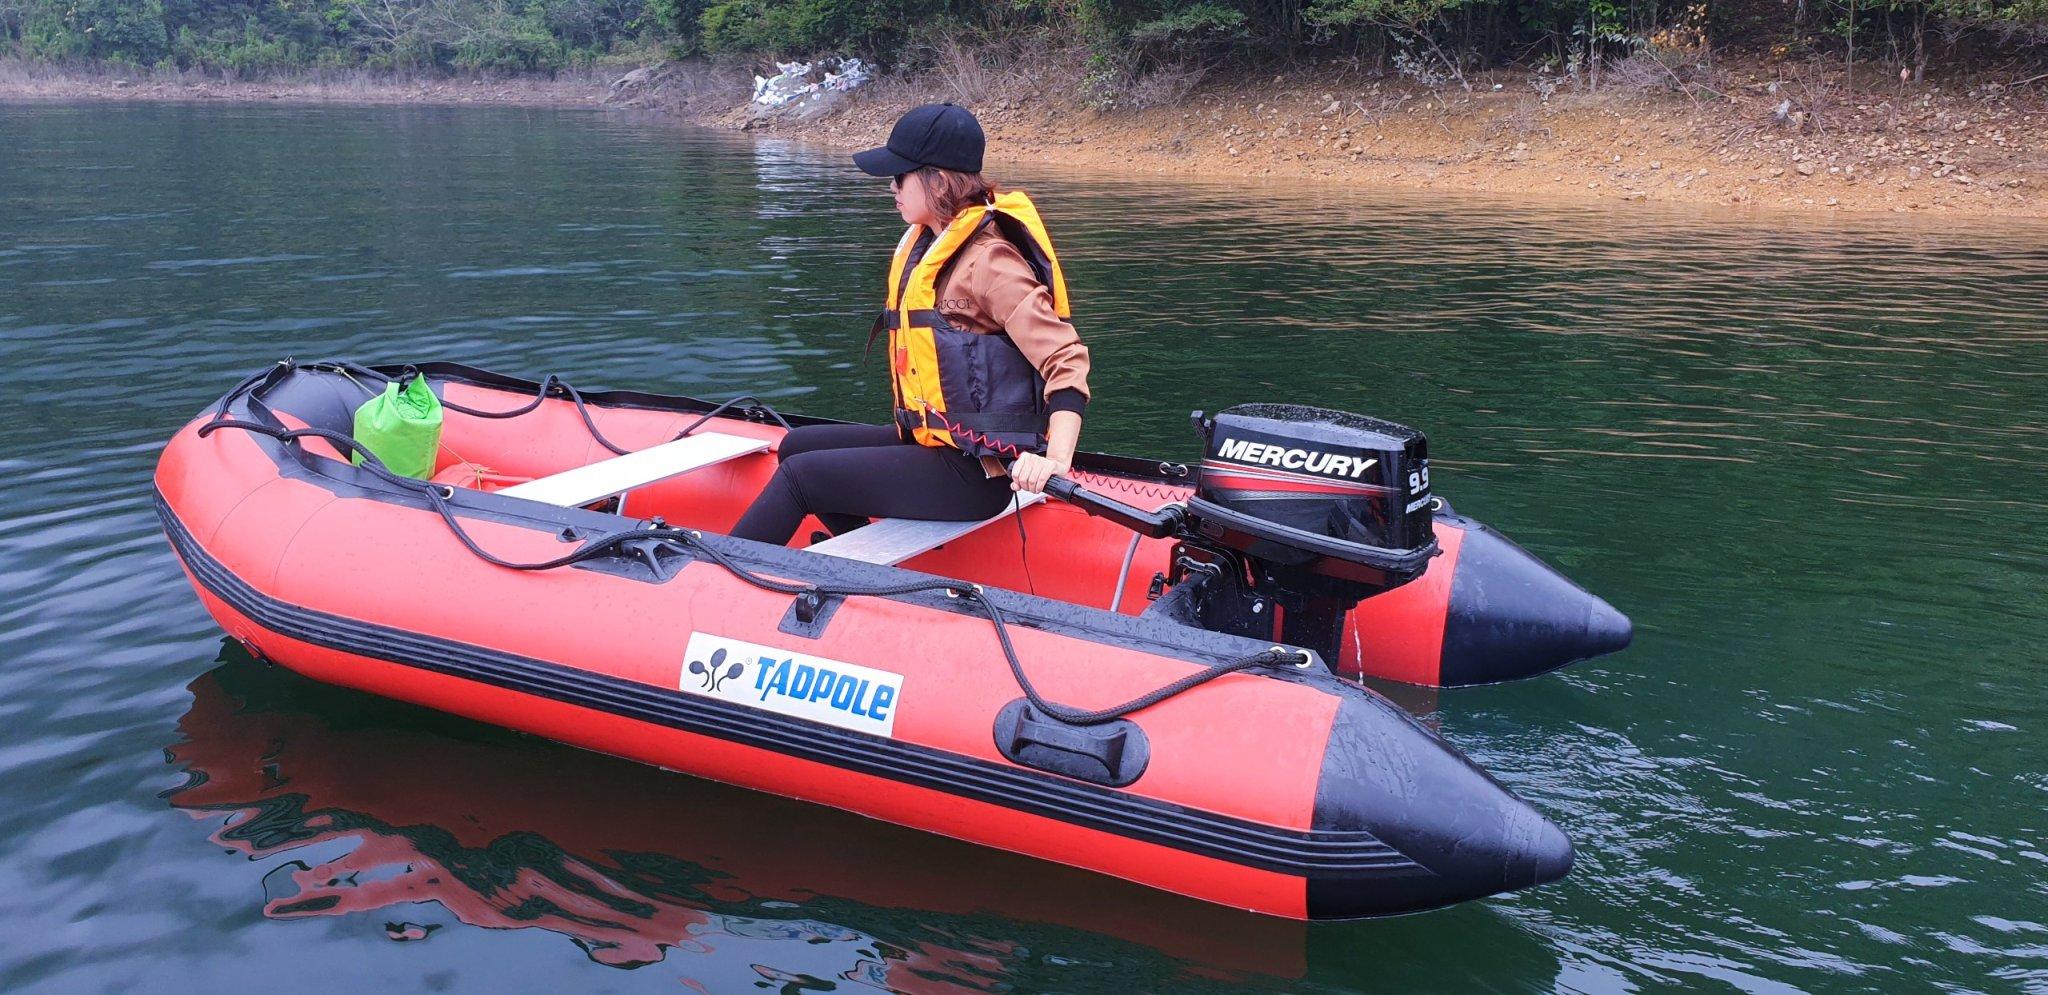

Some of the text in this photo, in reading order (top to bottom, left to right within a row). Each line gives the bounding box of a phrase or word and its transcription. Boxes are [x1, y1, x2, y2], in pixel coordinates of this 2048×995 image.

[940, 298, 970, 310] UCCI
[1218, 438, 1378, 477] MERCURY
[1409, 467, 1429, 495] 9.9
[755, 656, 895, 721] TADPOLE
